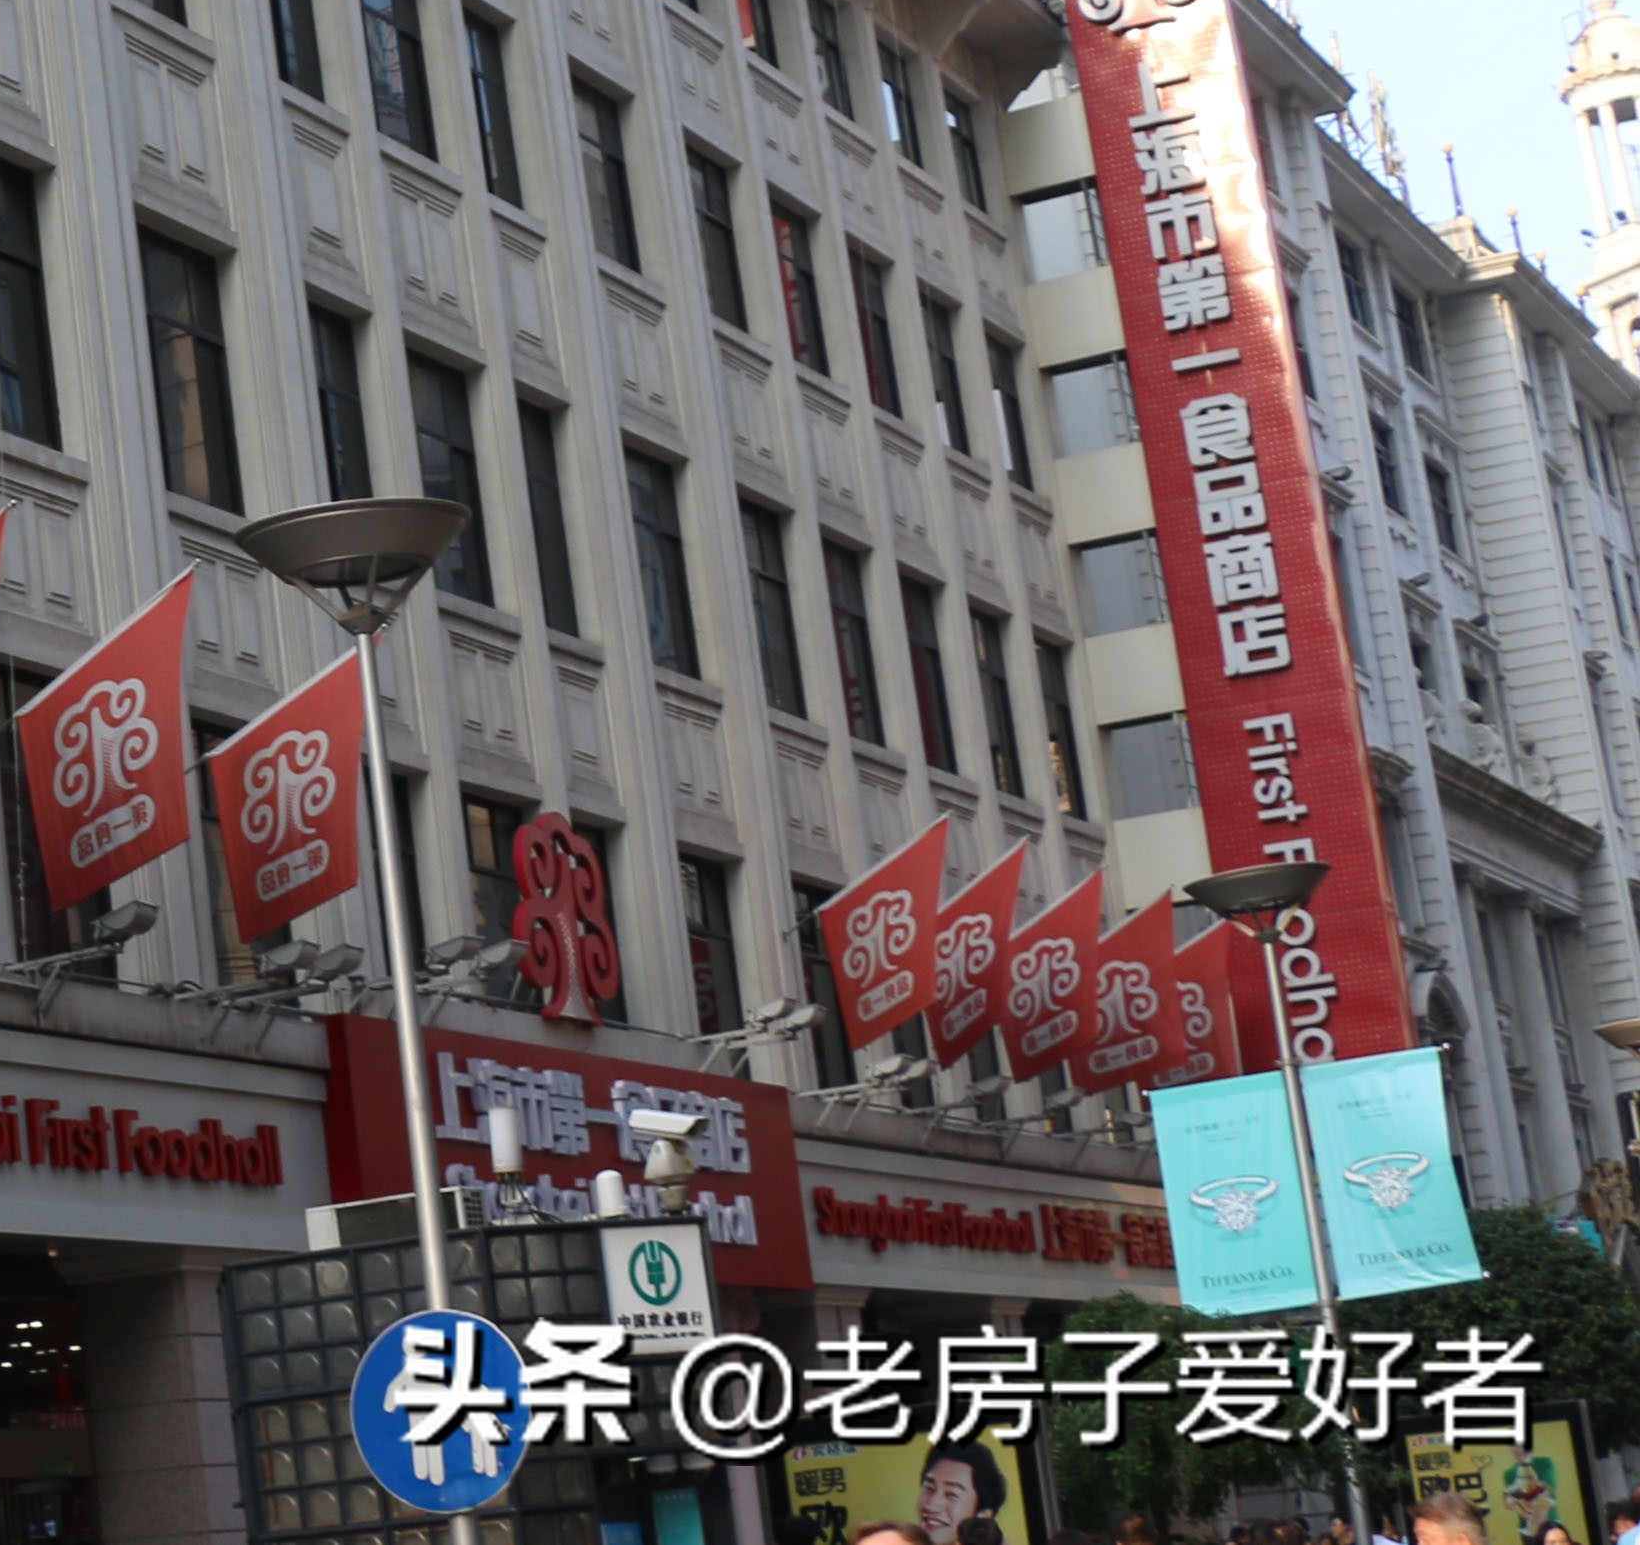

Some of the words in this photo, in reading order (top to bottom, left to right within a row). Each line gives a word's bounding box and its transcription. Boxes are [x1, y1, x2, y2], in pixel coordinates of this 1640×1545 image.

[1127, 60, 1291, 678] 上海市第一食品商店
[1242, 712, 1310, 825] First
[24, 1096, 110, 1171] First
[114, 1108, 284, 1187] Foodhall
[617, 1311, 703, 1329] 中国农业银行
